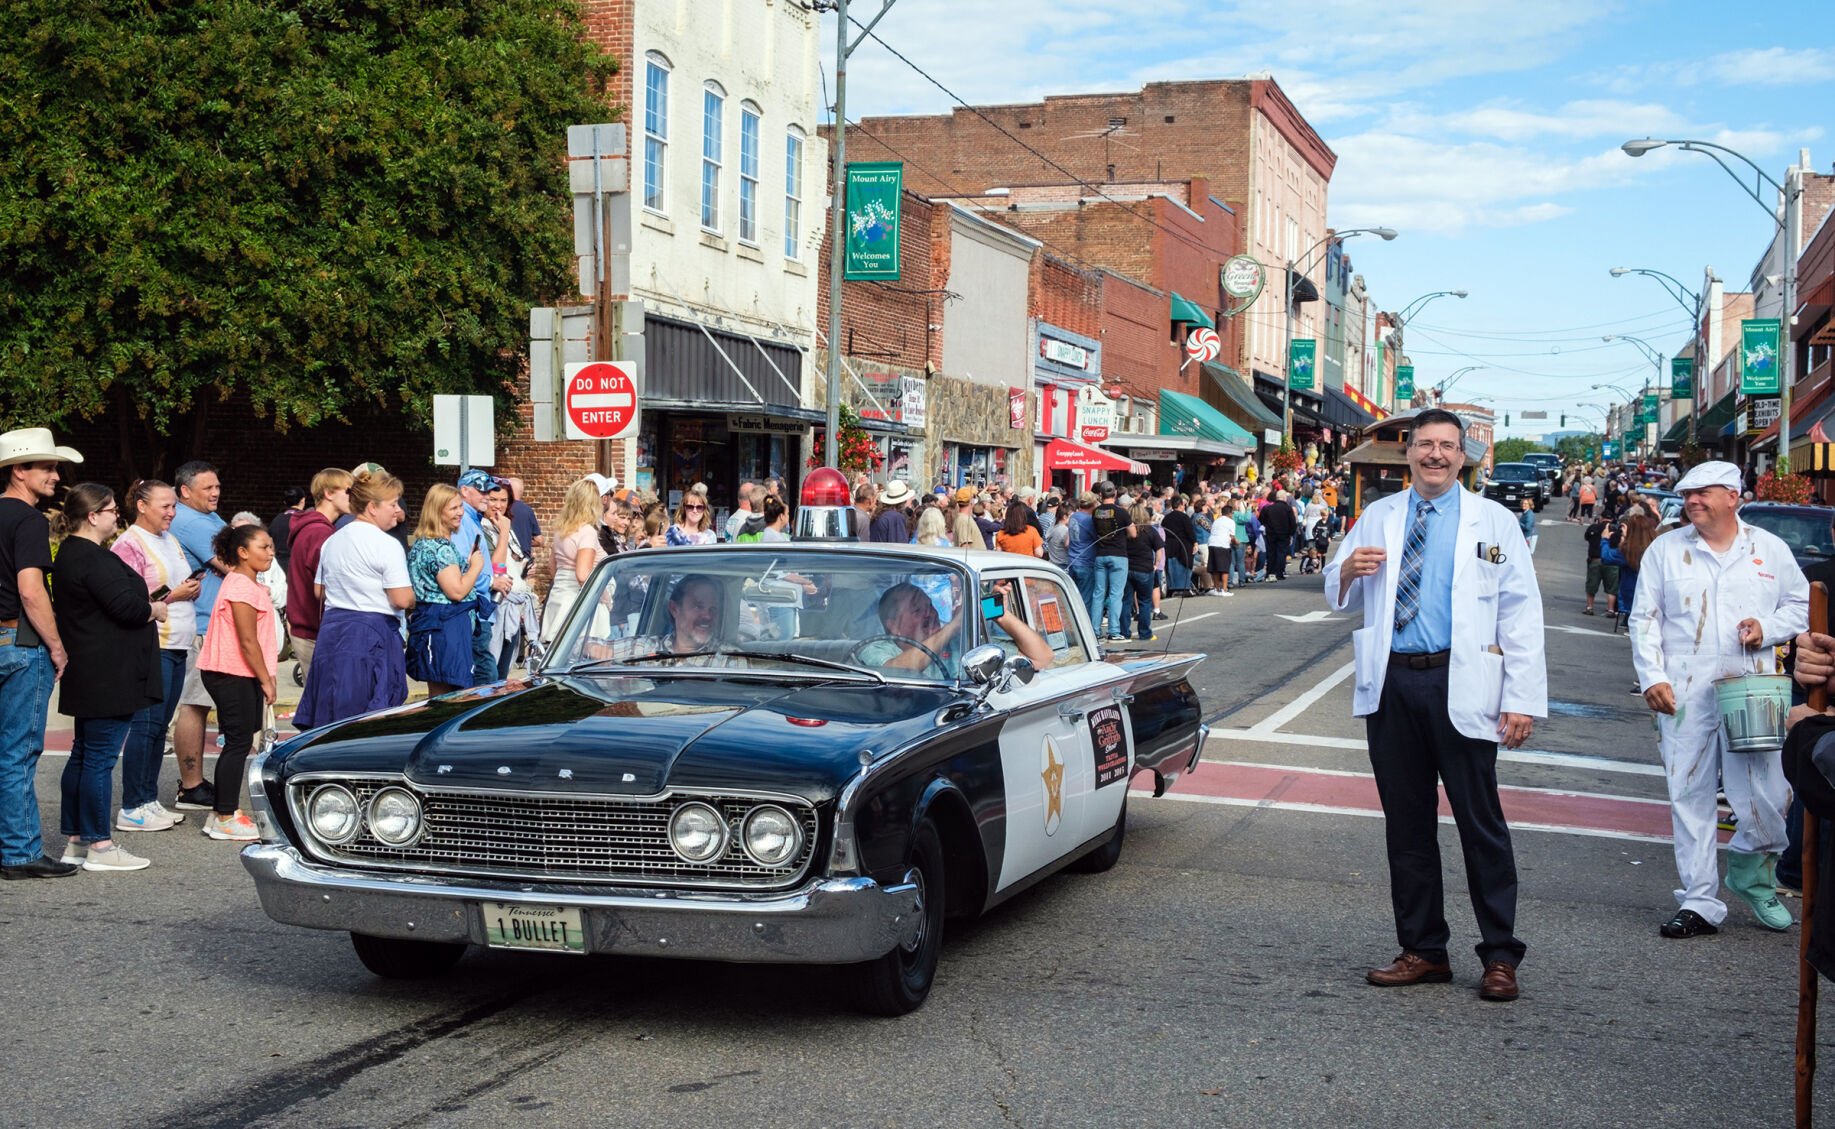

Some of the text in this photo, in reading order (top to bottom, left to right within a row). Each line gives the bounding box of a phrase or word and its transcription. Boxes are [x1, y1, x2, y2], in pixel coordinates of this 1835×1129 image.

[852, 175, 896, 184] Mount Airy
[852, 252, 890, 260] Welcomes
[576, 377, 625, 390] DO NOT
[1082, 406, 1111, 416] SNAPPY
[582, 411, 621, 424] ENTER
[1083, 416, 1109, 425] LUNCH
[738, 416, 762, 429] Fabric
[763, 417, 804, 432] Menagerie
[437, 764, 637, 783] FORD
[508, 905, 556, 917] Tennessee
[497, 917, 567, 943] 1 BULLET
